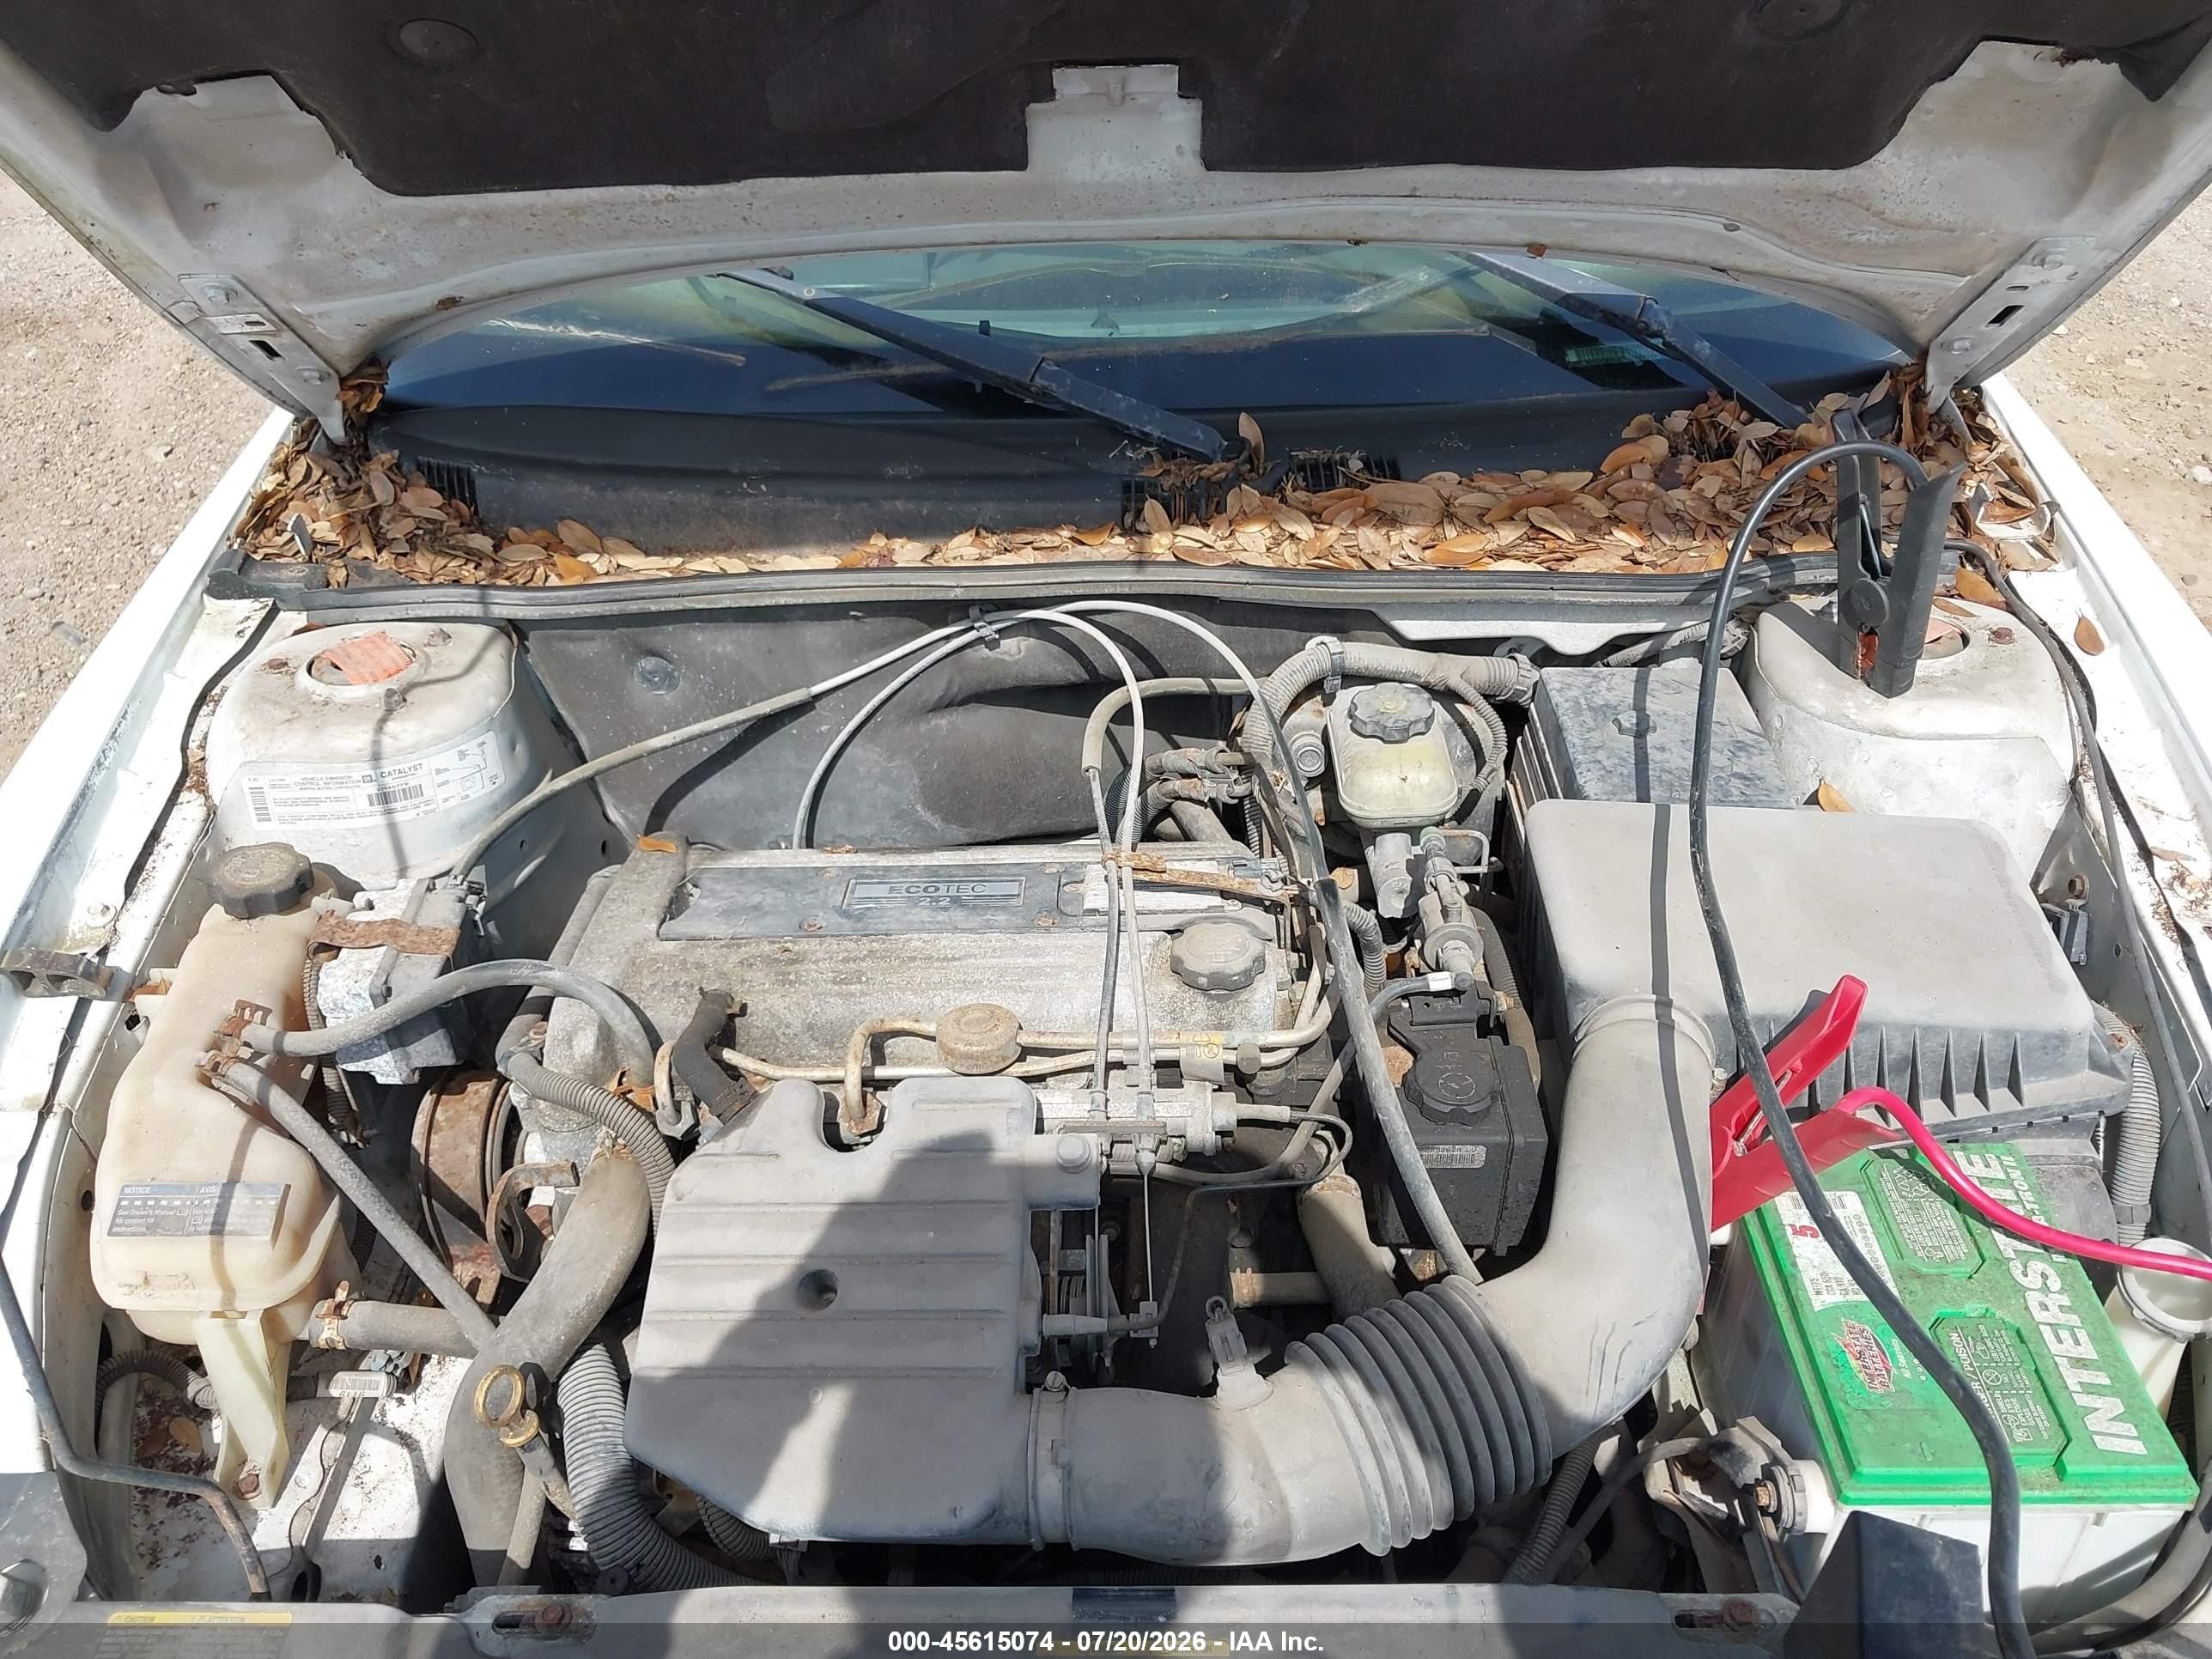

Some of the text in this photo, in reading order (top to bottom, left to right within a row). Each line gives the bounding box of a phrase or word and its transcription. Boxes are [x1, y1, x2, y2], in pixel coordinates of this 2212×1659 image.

[380, 763, 423, 779] CATALYST
[888, 884, 987, 895] ECOTEC
[919, 896, 951, 906] 2.2
[1788, 1224, 1820, 1238] 5
[1846, 1322, 1880, 1389] INTERSTATE
[1859, 1328, 1890, 1389] BATTERIES
[1949, 1332, 1974, 1371] POISON
[2000, 1373, 2010, 1382] NO
[1993, 1394, 2008, 1412] SHIELD
[2002, 1399, 2014, 1412] EYES
